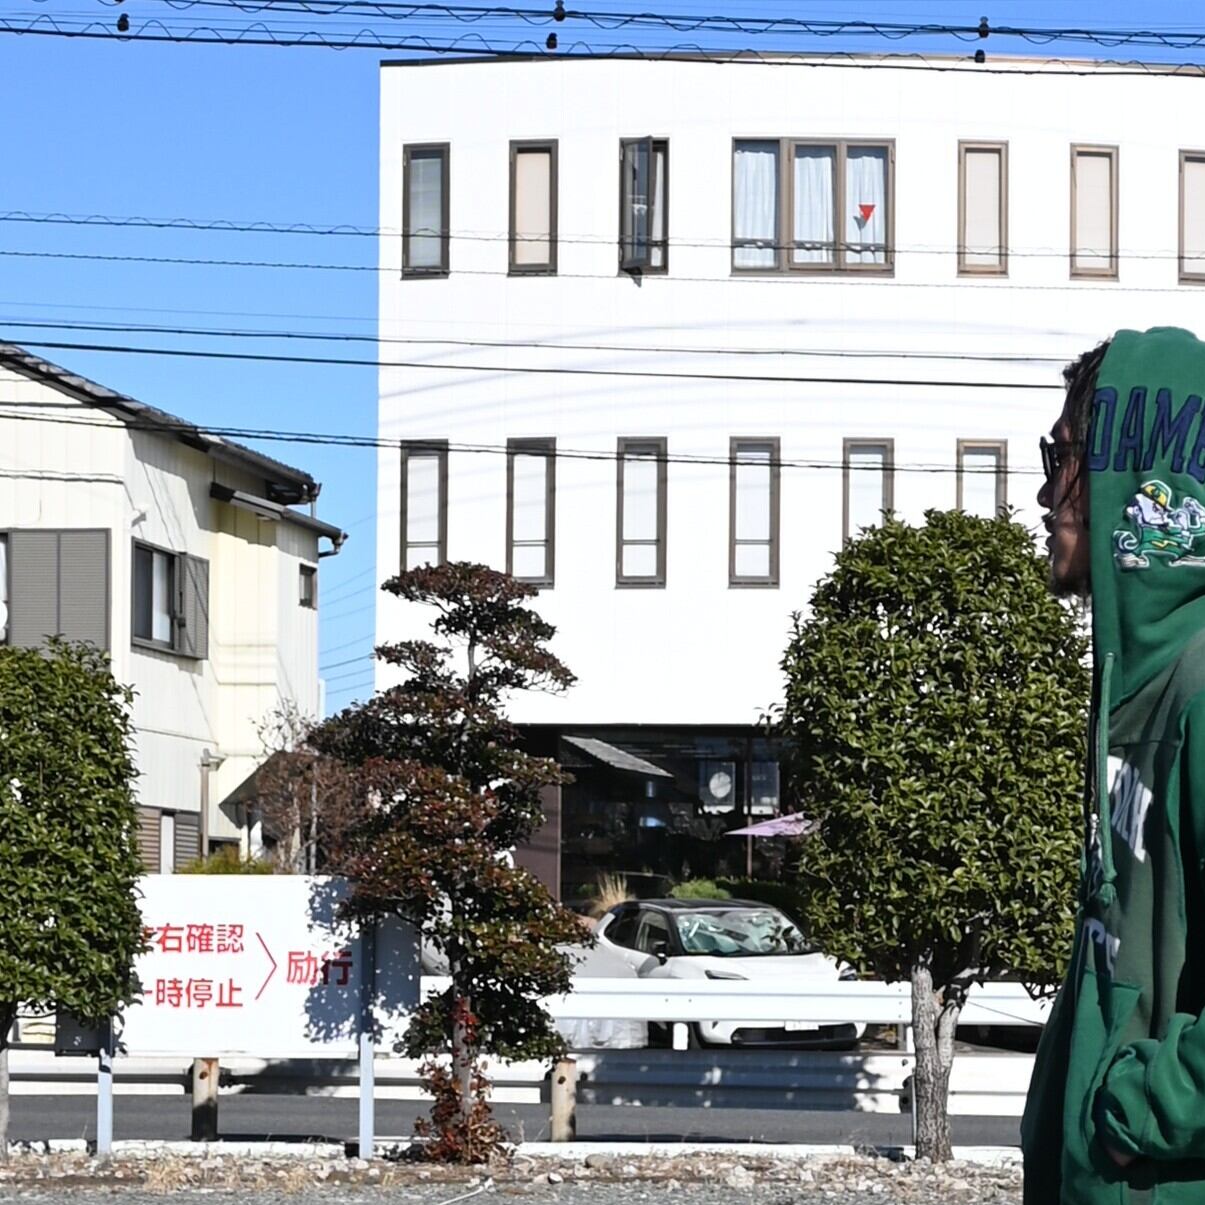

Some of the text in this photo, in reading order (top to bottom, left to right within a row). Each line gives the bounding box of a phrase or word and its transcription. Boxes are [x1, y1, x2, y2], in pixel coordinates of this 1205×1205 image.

[143, 922, 244, 952] 右確認
[287, 950, 353, 985] 励行
